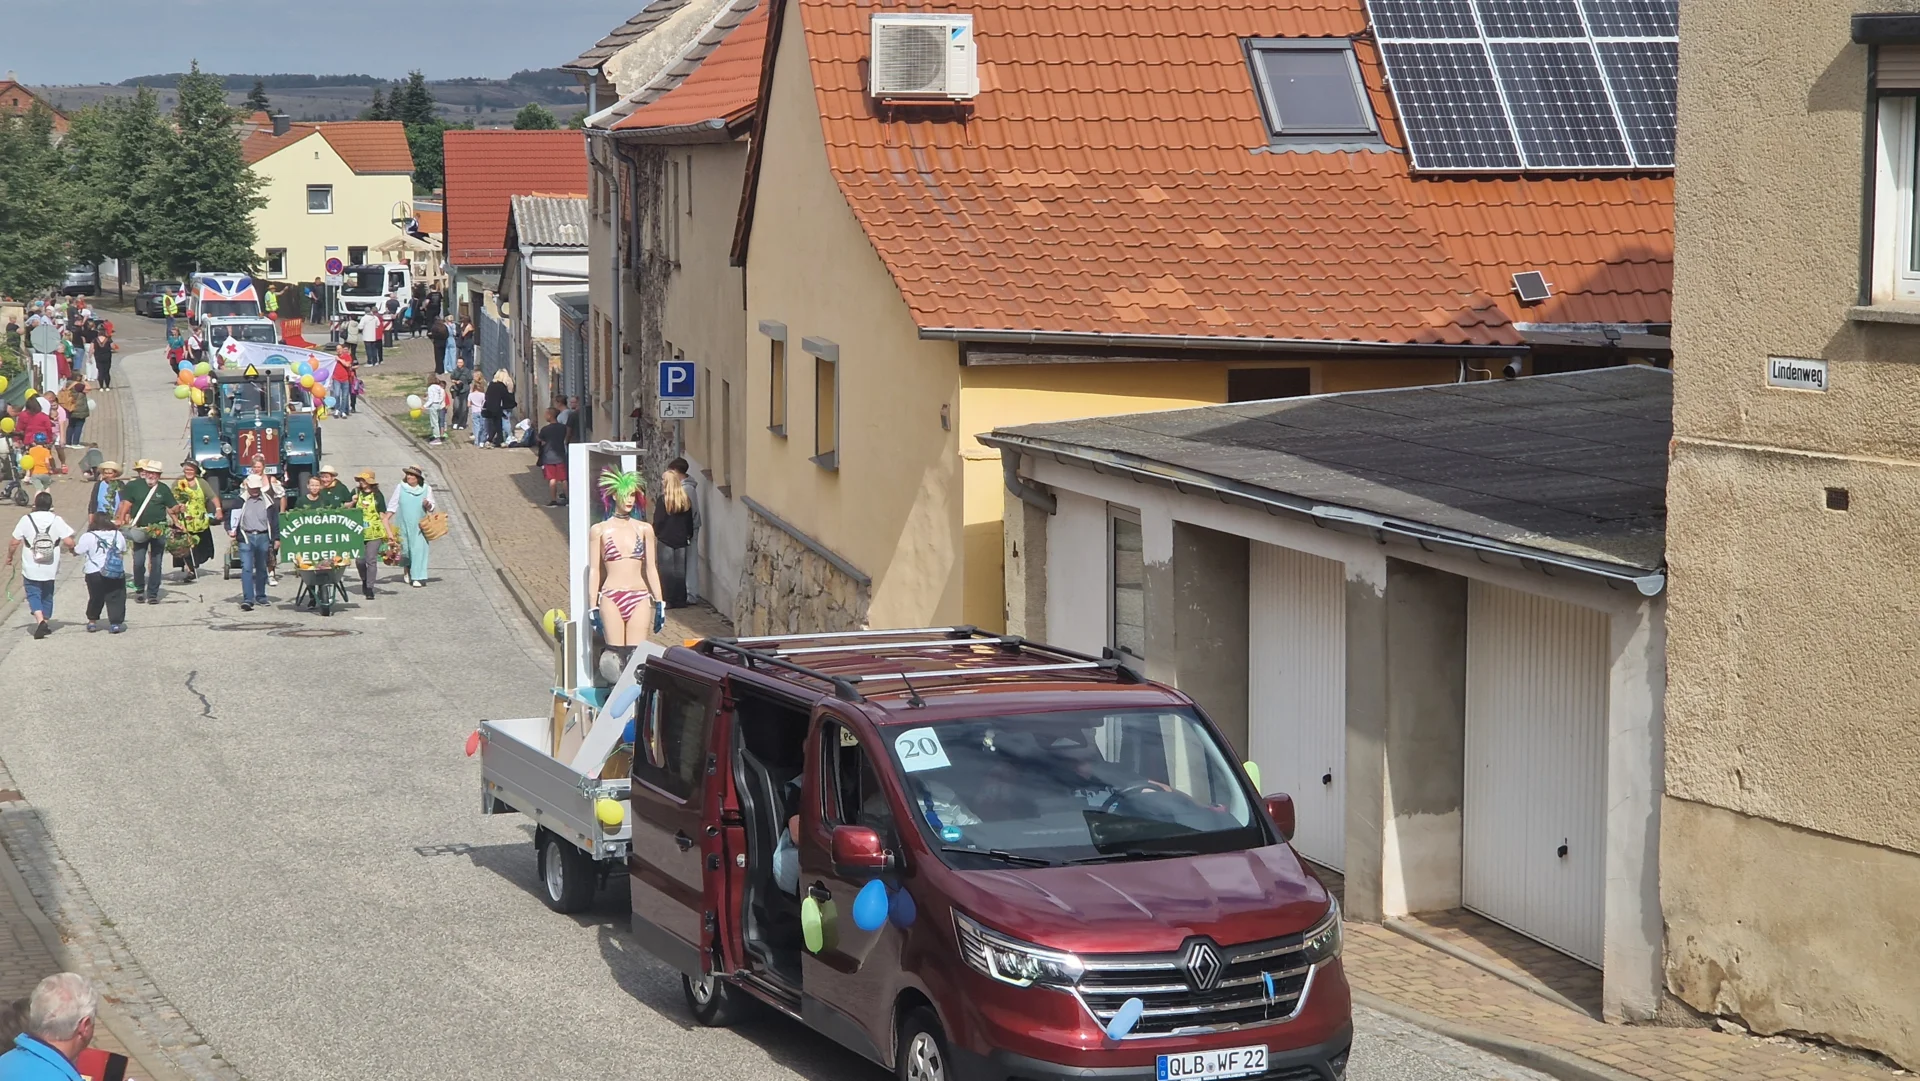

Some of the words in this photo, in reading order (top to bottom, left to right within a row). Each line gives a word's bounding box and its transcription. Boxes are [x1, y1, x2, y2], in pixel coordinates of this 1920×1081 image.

[668, 366, 687, 393] P
[1773, 360, 1823, 387] Lindenweg
[293, 534, 350, 545] VEREIN
[285, 551, 338, 561] REDER
[899, 737, 938, 759] 20
[1170, 1055, 1204, 1076] QLB
[1217, 1052, 1239, 1071] WF
[1244, 1049, 1264, 1069] 22
